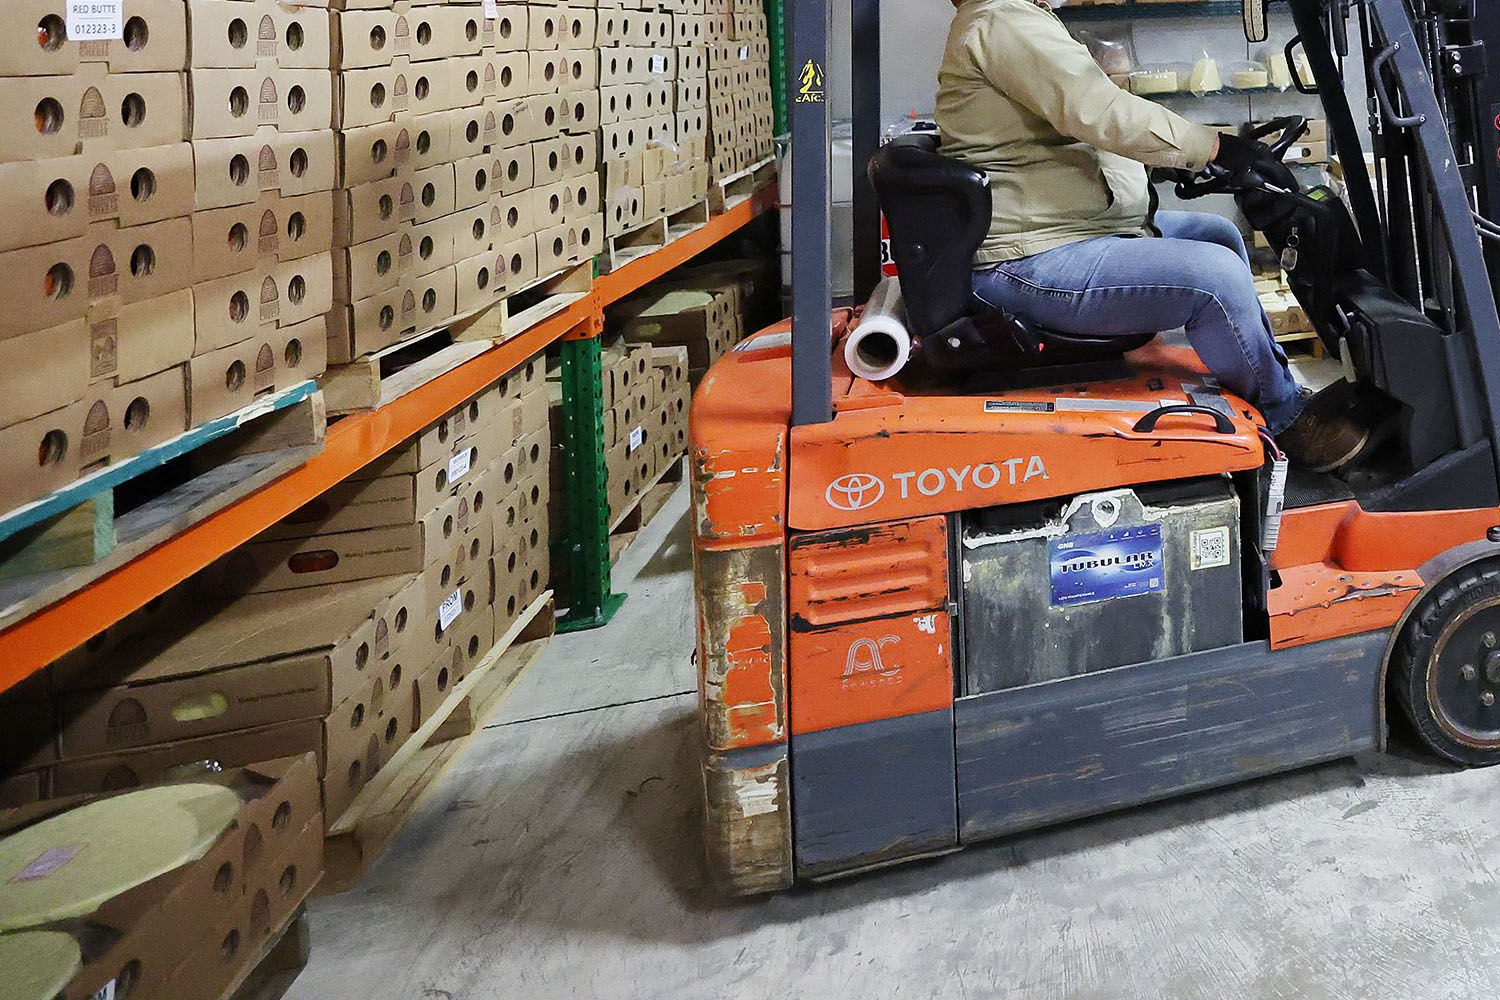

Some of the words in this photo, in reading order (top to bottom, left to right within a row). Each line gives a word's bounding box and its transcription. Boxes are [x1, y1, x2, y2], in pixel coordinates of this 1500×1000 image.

[73, 5, 89, 13] RED
[92, 5, 116, 13] BUTTE
[75, 24, 116, 34] 012323-3
[892, 456, 1050, 499] TOYOTA
[1060, 551, 1154, 574] TUBULAR
[1133, 560, 1155, 569] LMX
[843, 634, 902, 677] AC
